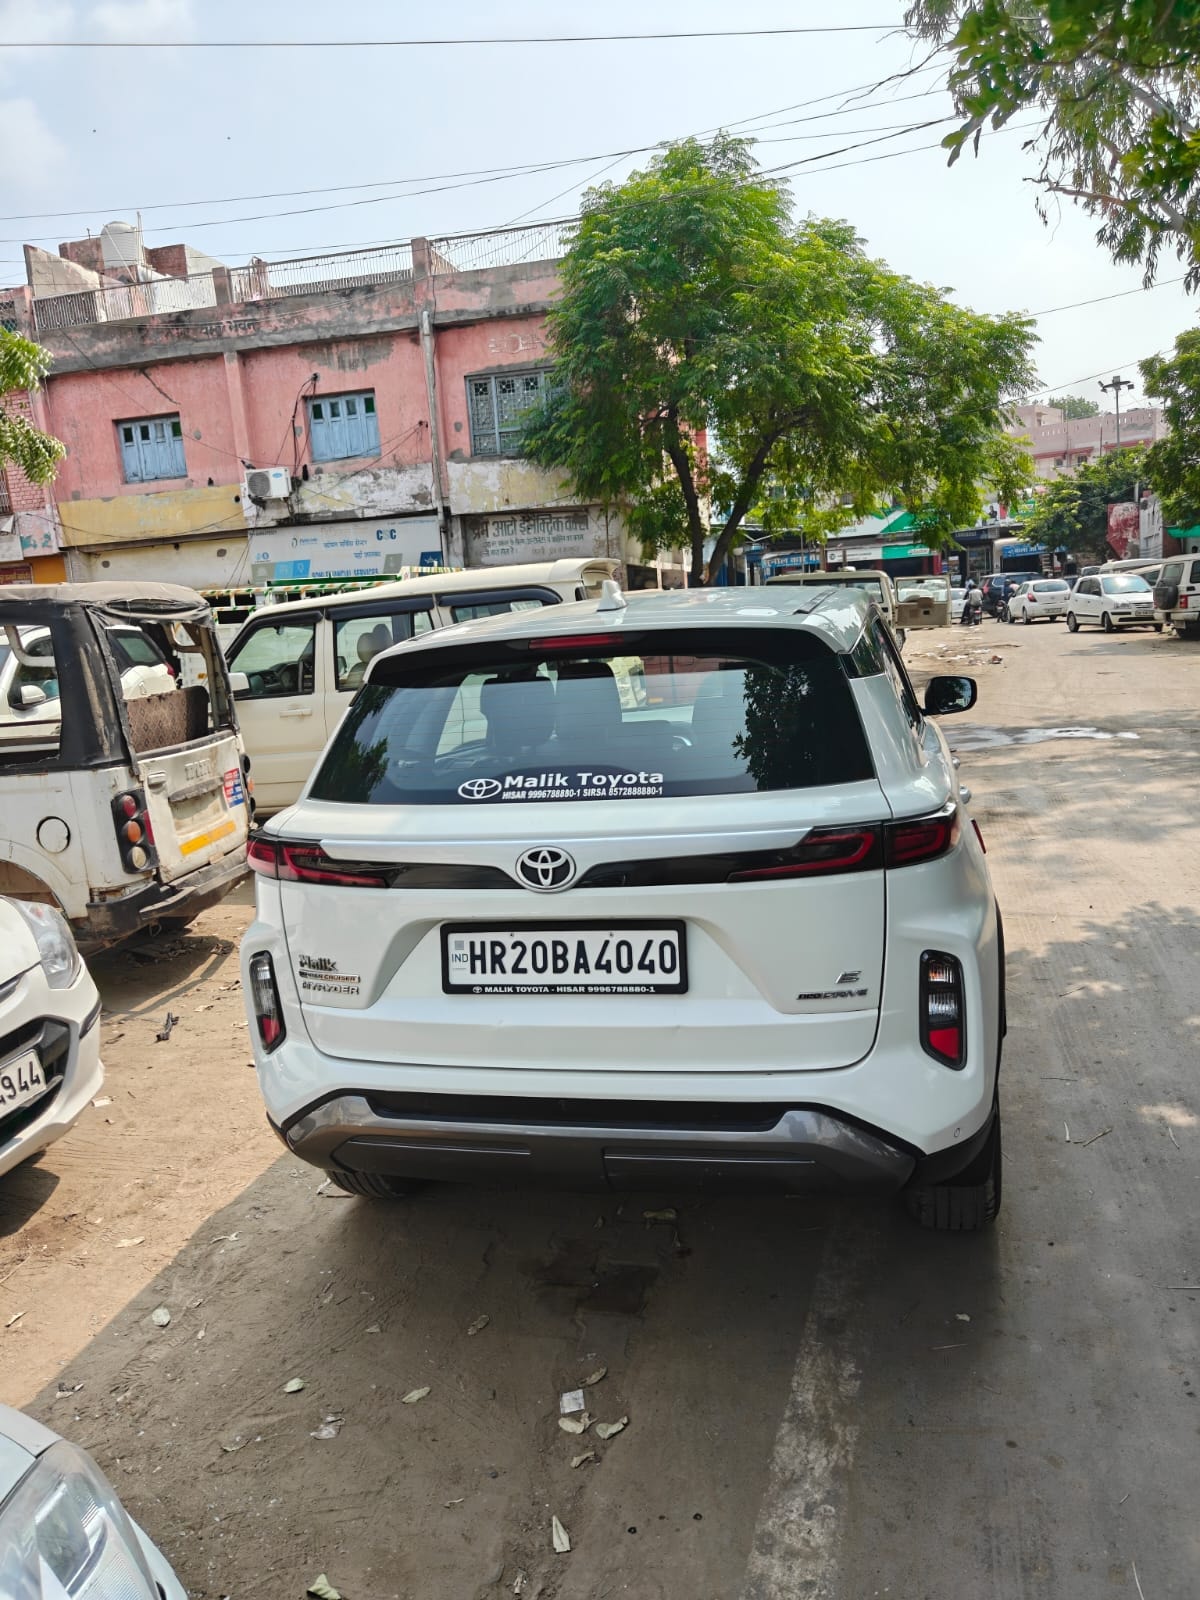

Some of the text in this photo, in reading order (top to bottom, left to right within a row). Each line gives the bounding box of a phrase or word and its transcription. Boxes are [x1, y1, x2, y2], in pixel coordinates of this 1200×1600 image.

[376, 529, 397, 541] CSC
[504, 771, 664, 788] Malik Toyota
[502, 790, 527, 799] HISAR
[527, 789, 581, 799] 9996788880-1
[582, 788, 607, 797] SIRSA
[451, 940, 677, 974] IND HR20BA4040
[587, 985, 656, 993] 9996788880-1
